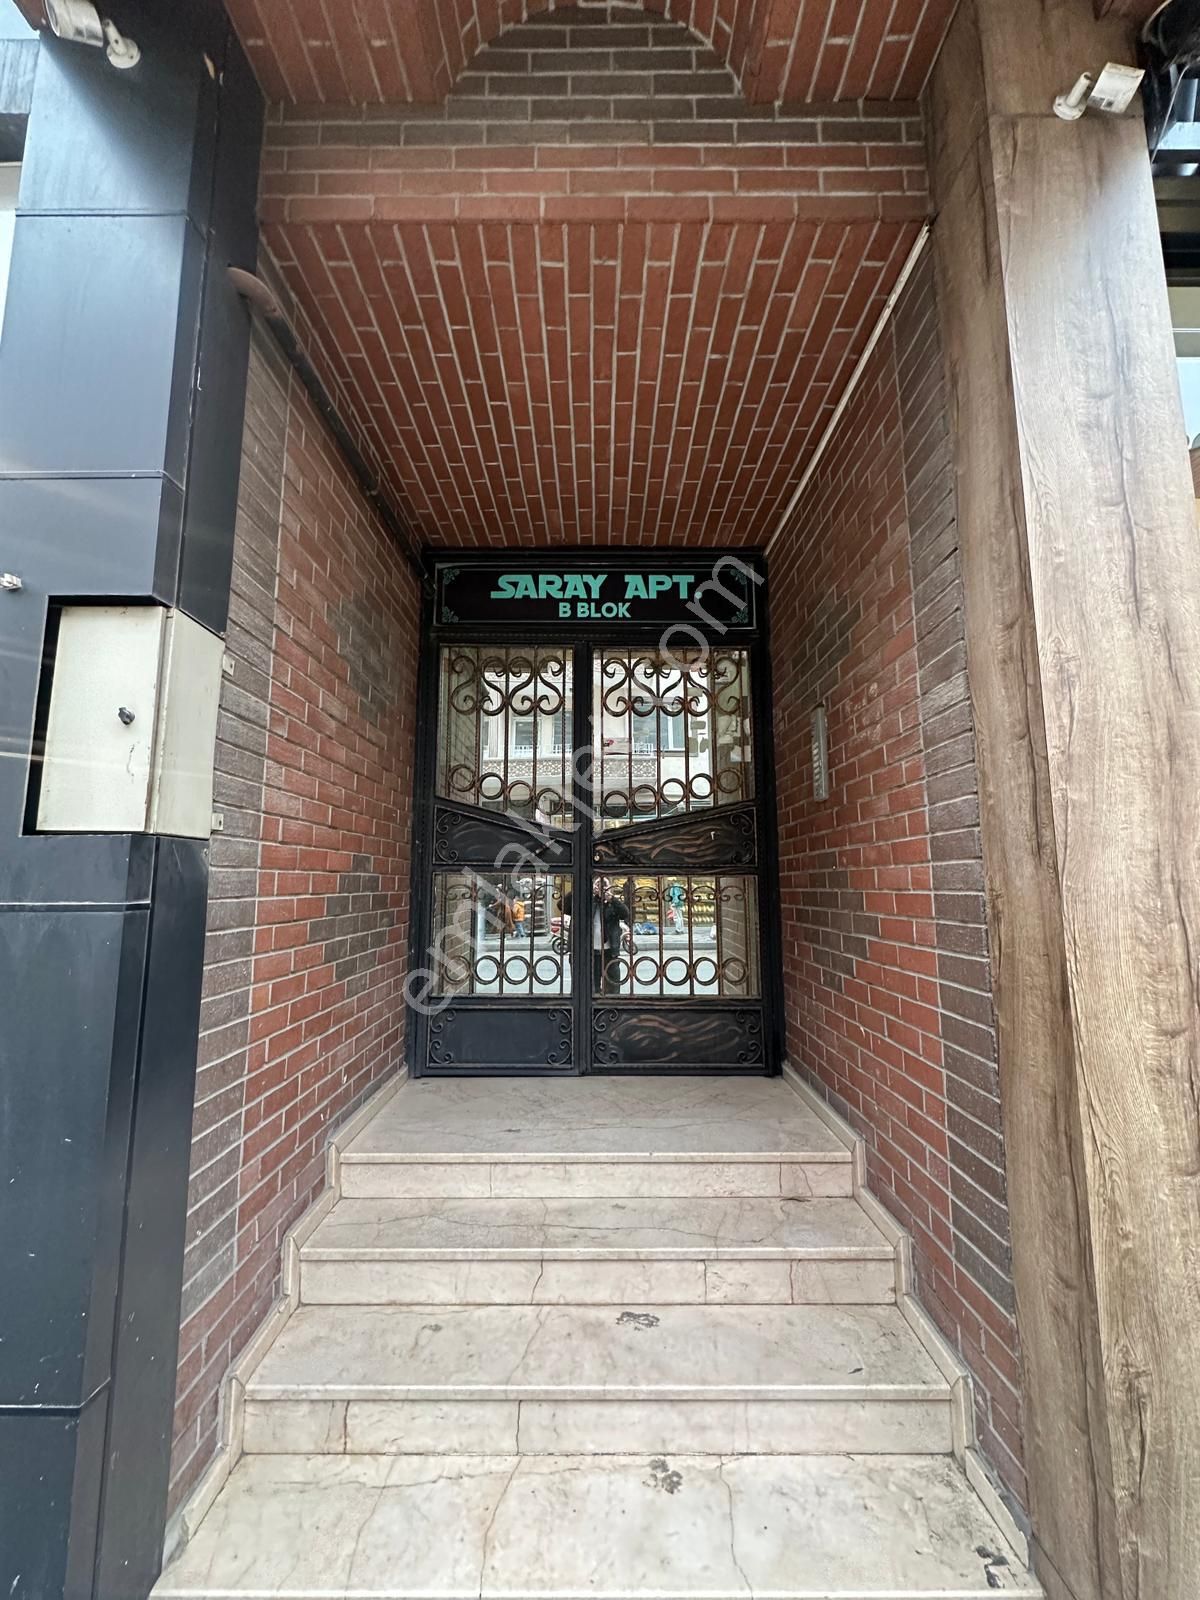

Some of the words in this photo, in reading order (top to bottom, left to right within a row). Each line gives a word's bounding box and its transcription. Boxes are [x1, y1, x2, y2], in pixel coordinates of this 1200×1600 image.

[490, 574, 608, 599] SARAY
[624, 574, 703, 599] APT.
[558, 602, 572, 618] B
[576, 602, 632, 618] BLOK
